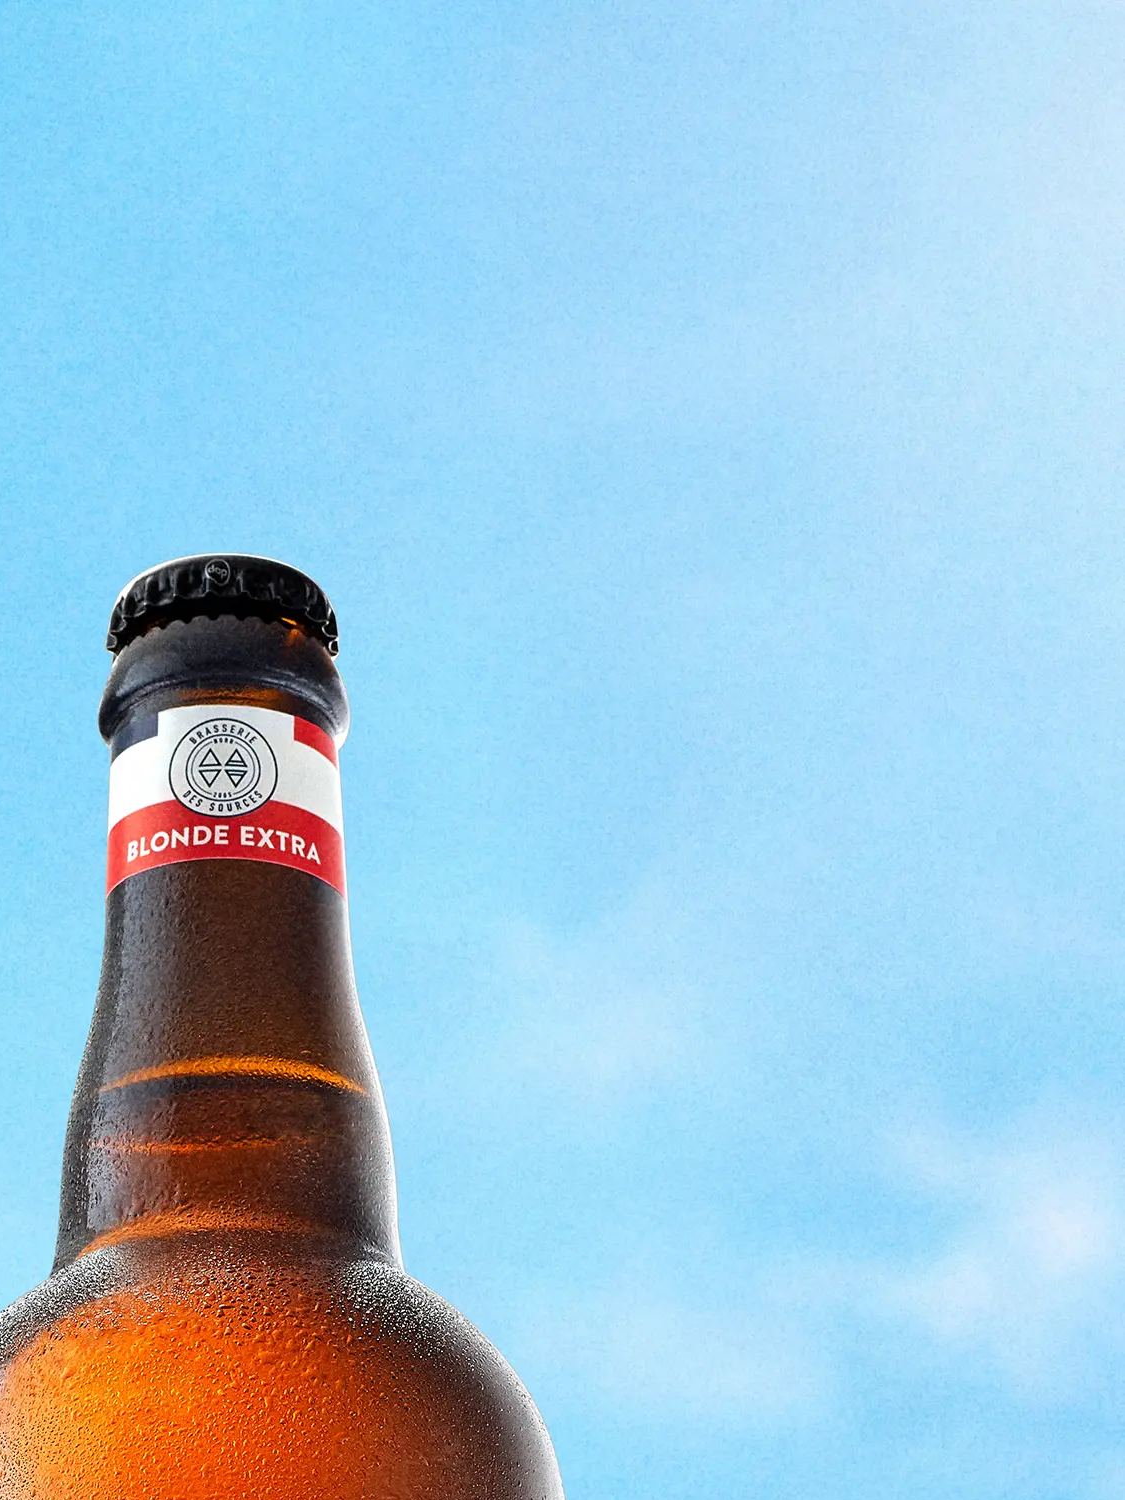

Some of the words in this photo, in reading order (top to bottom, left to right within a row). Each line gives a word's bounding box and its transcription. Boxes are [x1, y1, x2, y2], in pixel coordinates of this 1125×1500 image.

[189, 724, 258, 744] BRASSERIE
[183, 790, 203, 807] DES
[209, 790, 263, 812] SOURCES
[127, 825, 229, 862] BLONDE
[240, 827, 321, 864] EXTRA
